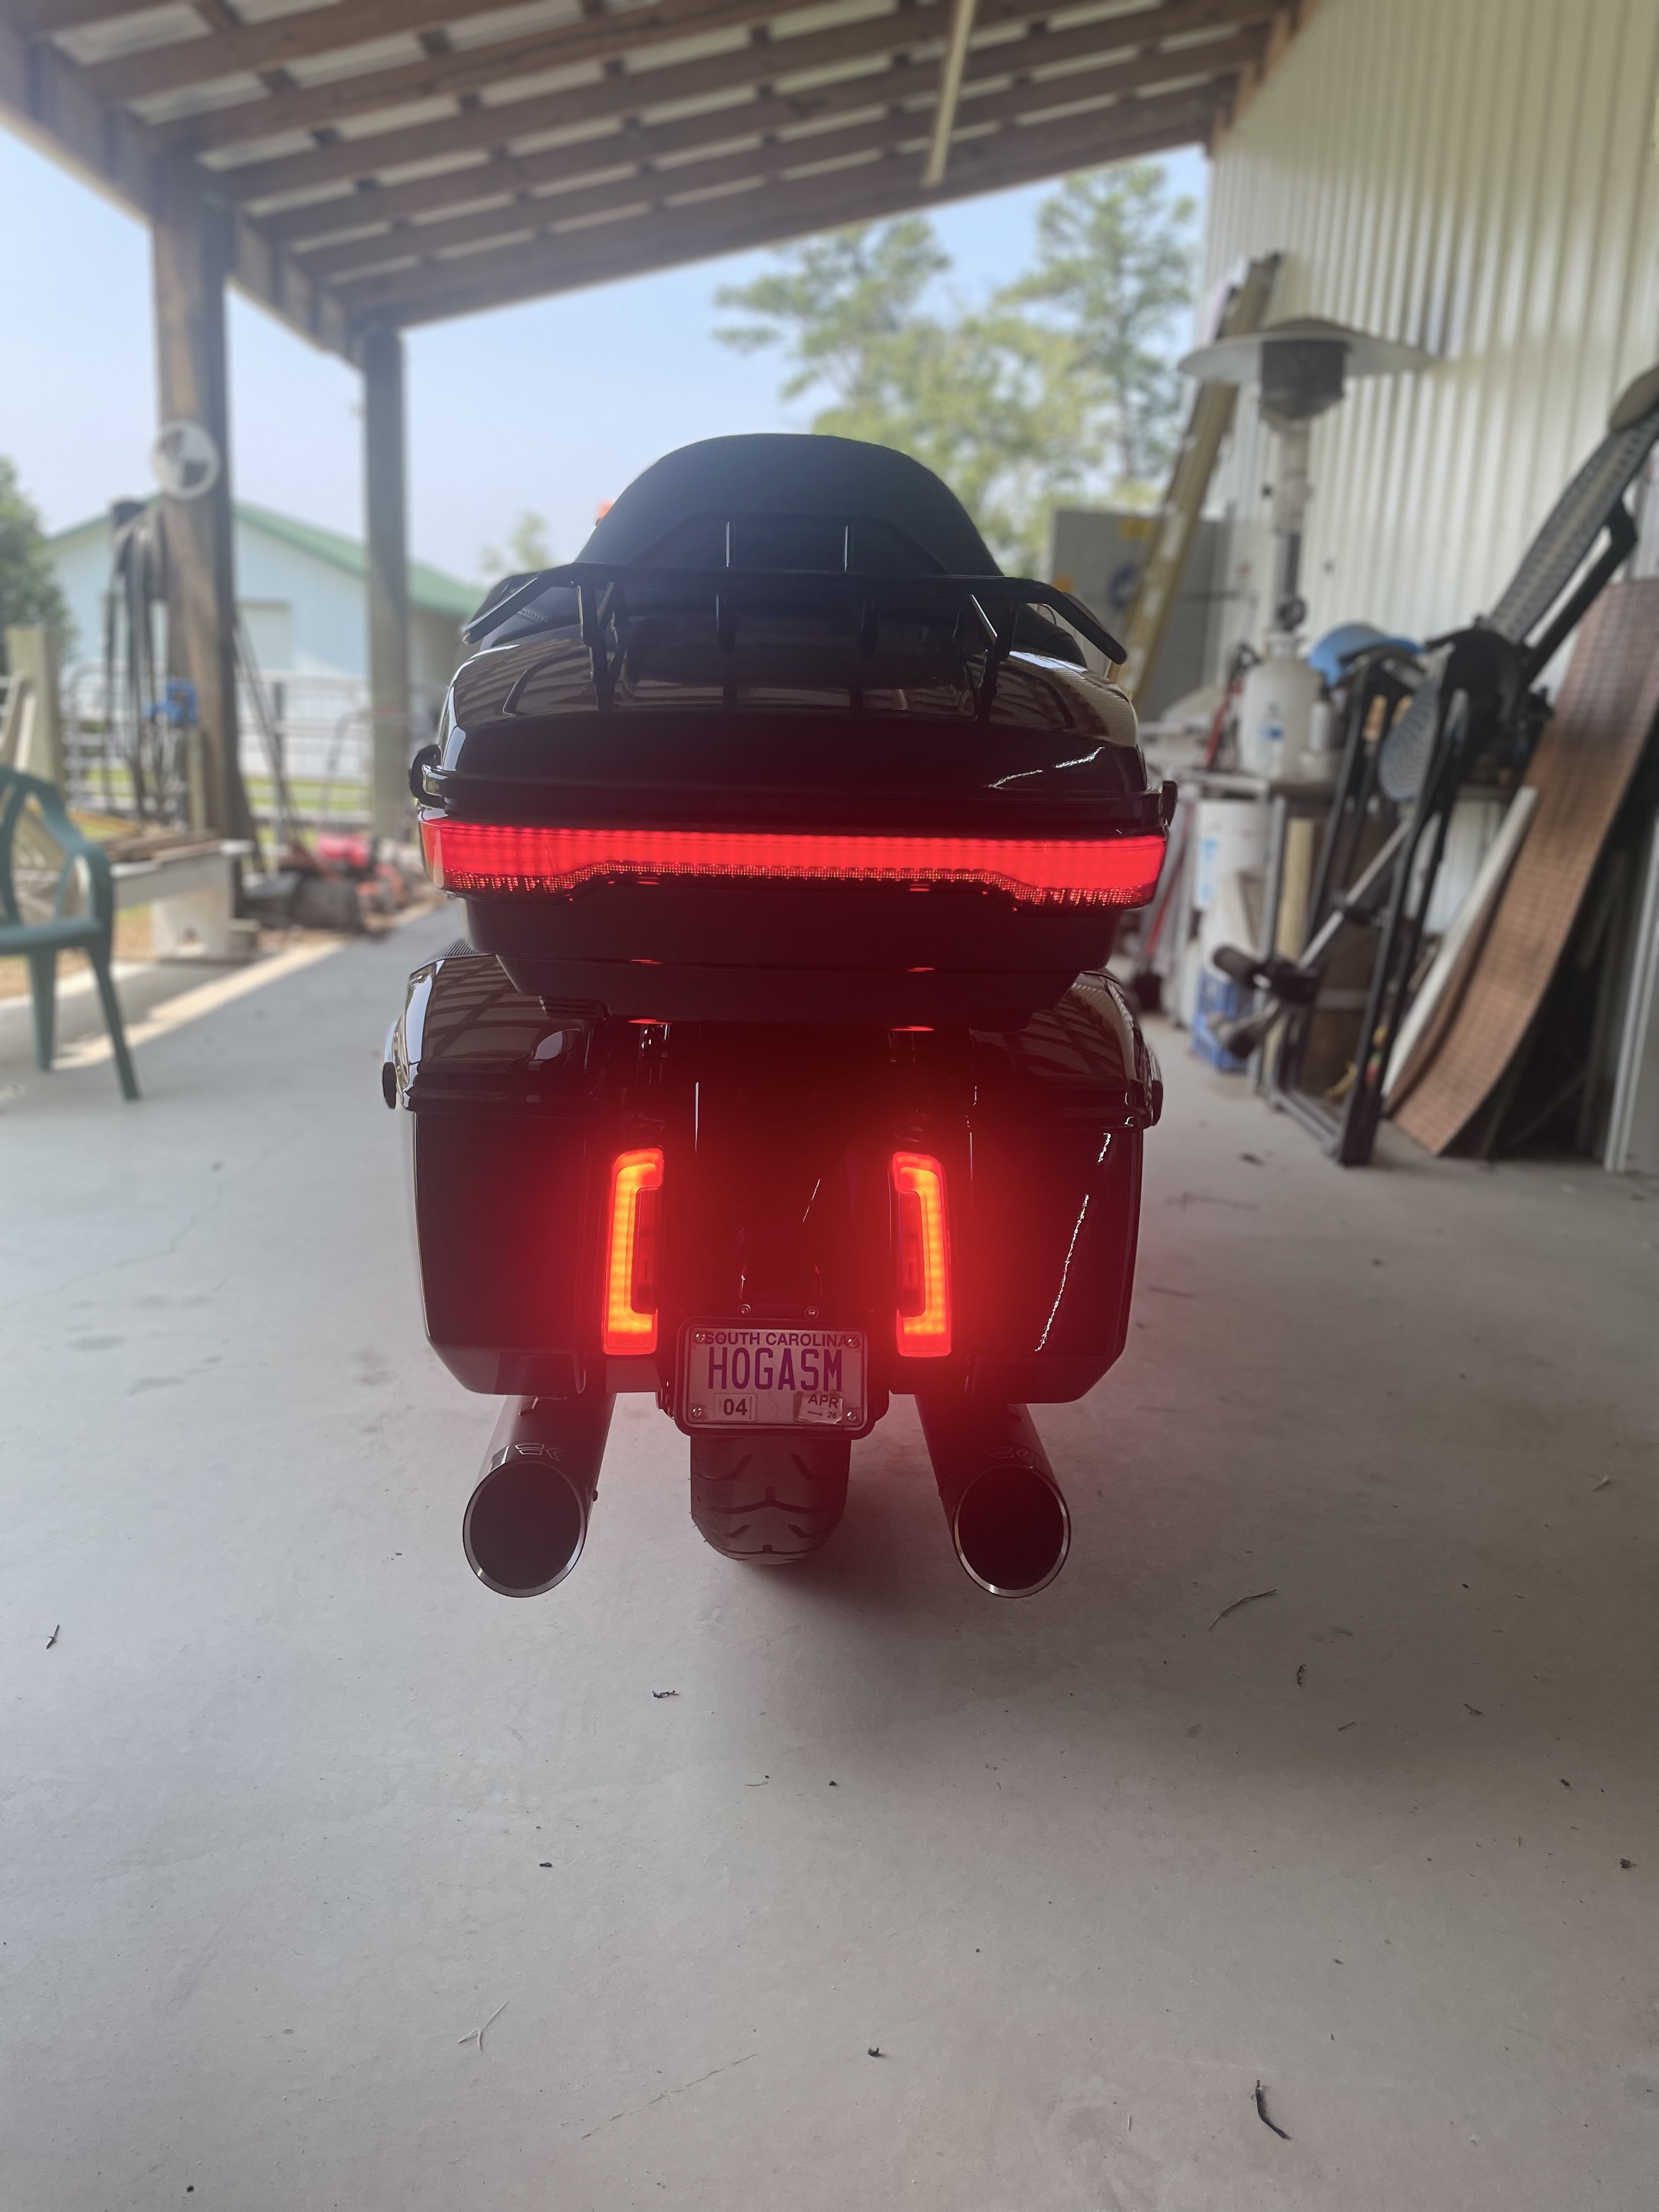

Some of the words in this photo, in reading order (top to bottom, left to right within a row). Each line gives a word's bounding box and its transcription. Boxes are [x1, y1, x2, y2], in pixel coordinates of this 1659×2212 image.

[706, 1332, 760, 1345] SOUTH
[765, 1333, 849, 1347] CAROLINA
[708, 1347, 842, 1392] HOGASM
[723, 1398, 747, 1415] 04
[808, 1393, 838, 1409] APR
[827, 1411, 837, 1419] 26
